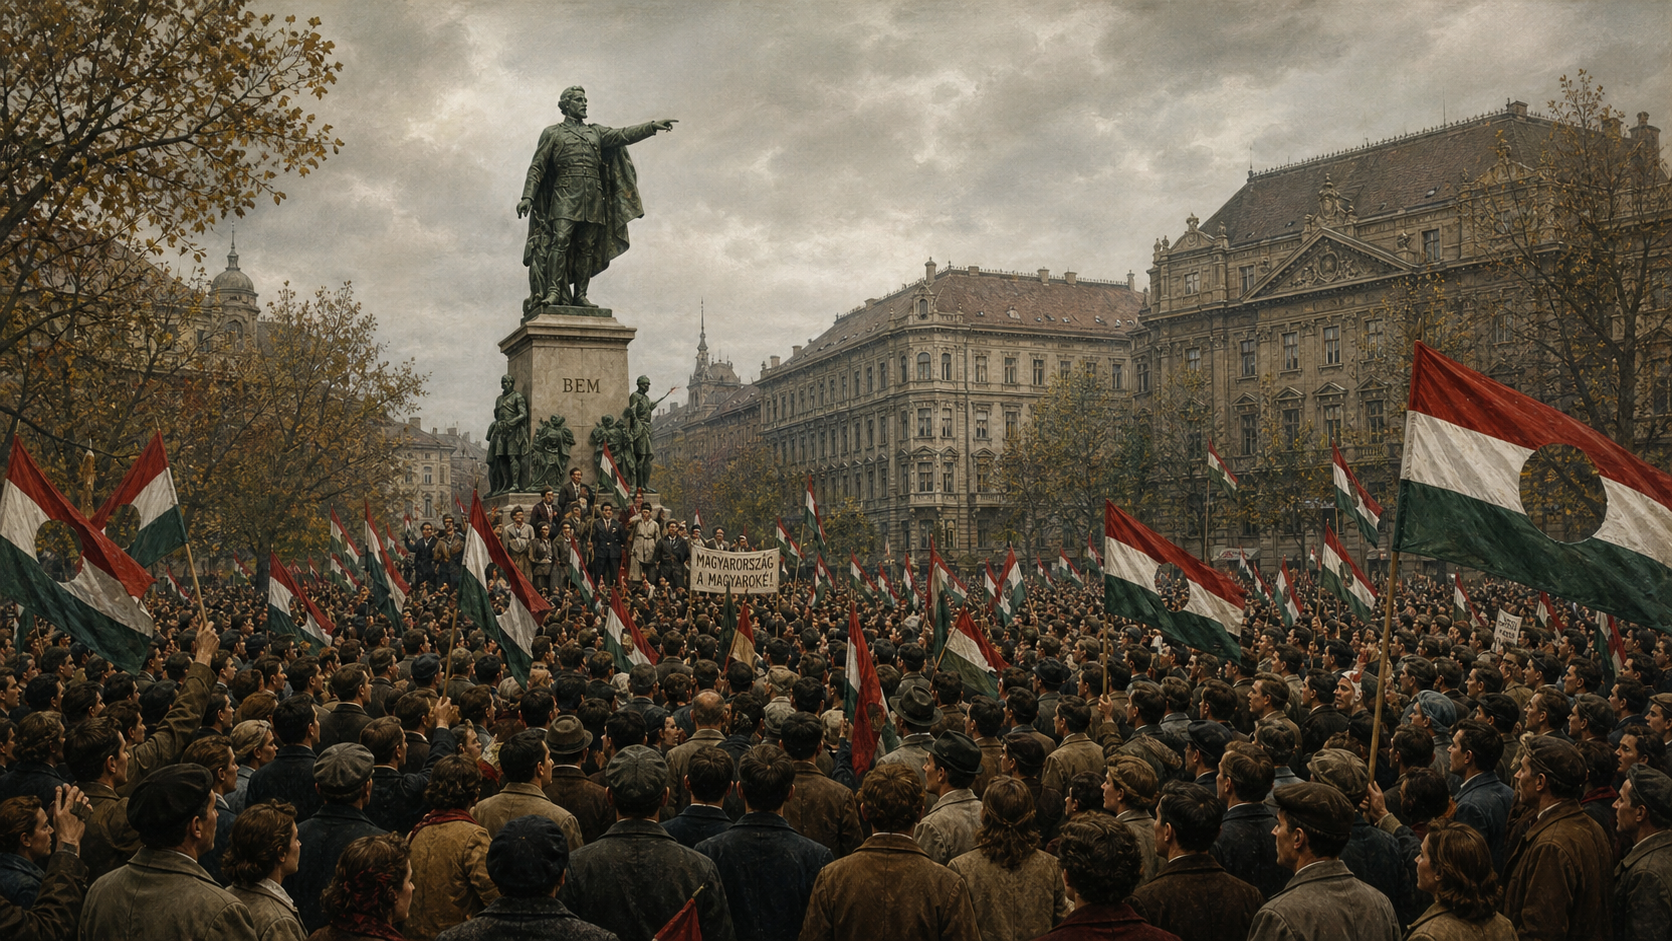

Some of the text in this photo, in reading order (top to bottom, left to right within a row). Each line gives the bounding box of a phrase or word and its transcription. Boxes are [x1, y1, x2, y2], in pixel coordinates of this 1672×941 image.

[562, 377, 601, 394] BEM
[696, 553, 774, 571] MAGYARORSZÁG
[696, 572, 774, 588] A MAGYAROKÉ!
